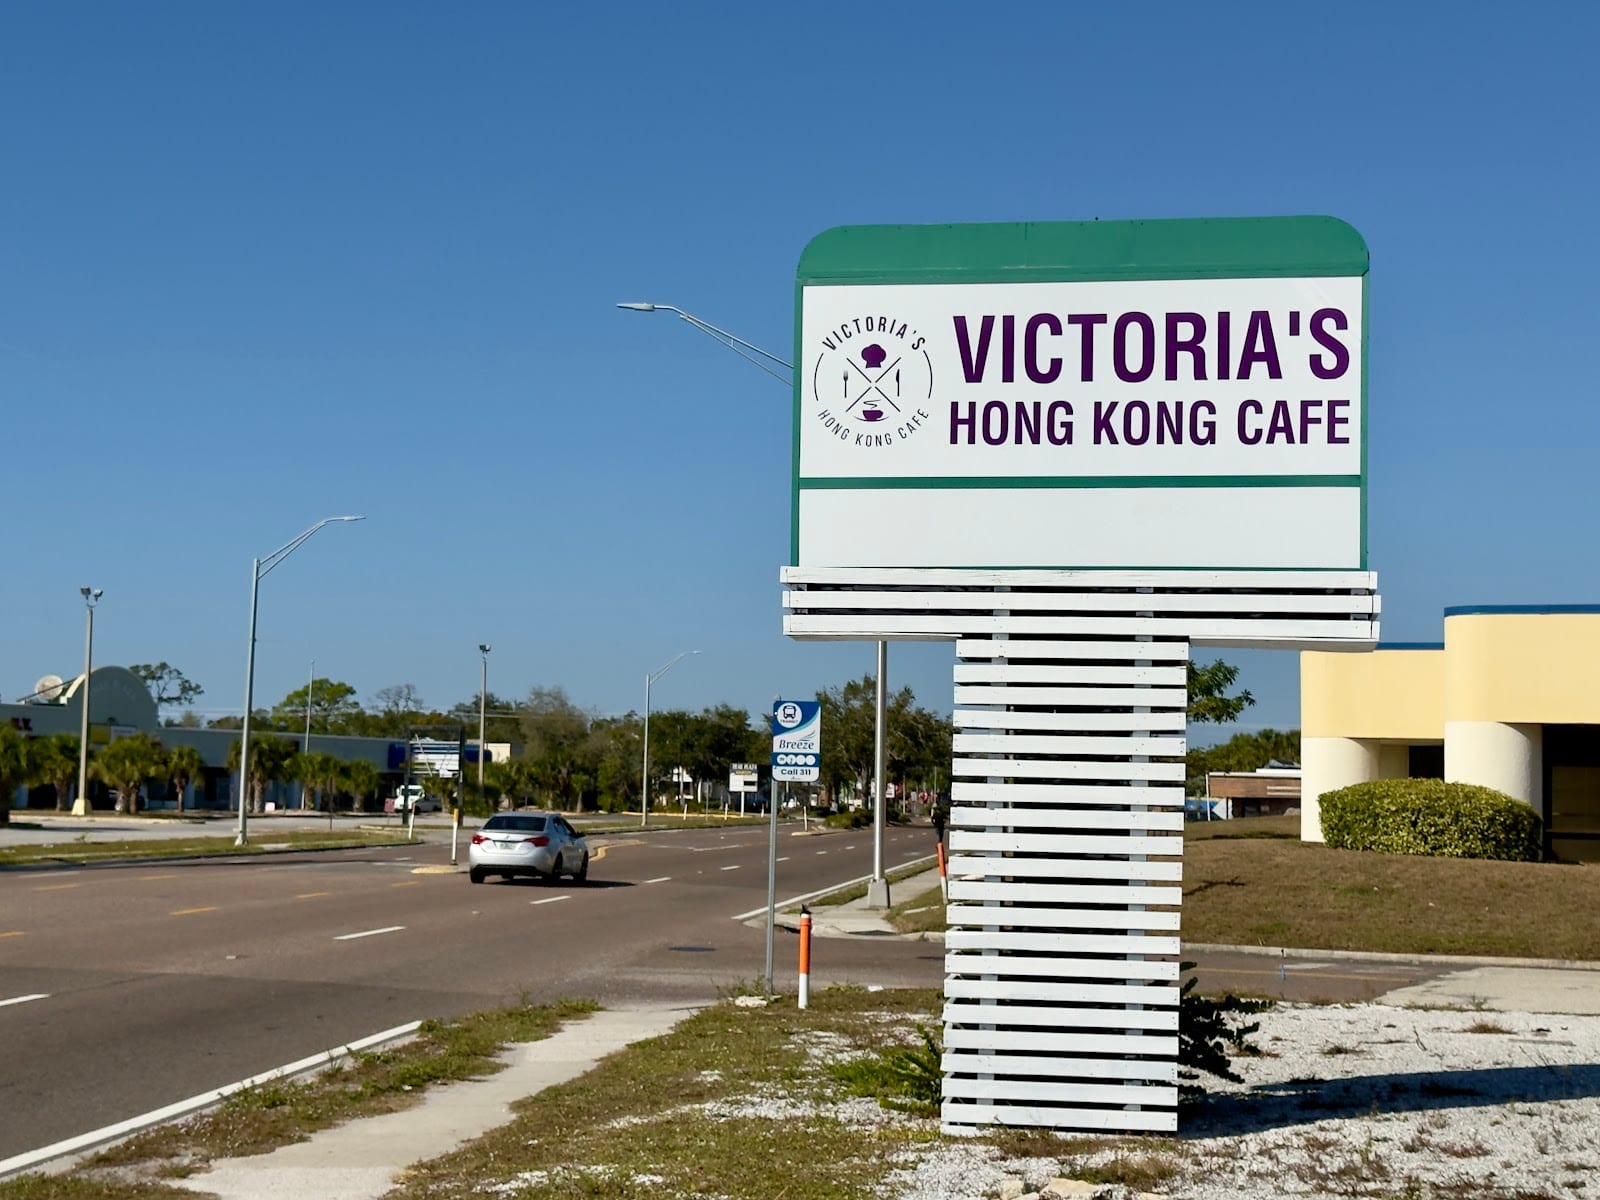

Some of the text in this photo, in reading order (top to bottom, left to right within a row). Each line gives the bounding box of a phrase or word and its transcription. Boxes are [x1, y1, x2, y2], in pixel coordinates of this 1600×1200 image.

[821, 315, 926, 352] VICTORIA'S
[953, 307, 1350, 385] VICTORIA'S
[817, 408, 930, 448] HONG KONG CAFE
[950, 400, 1351, 446] HONG KONG CAFE
[779, 739, 815, 750] Breeze
[780, 768, 811, 776] Call 311
